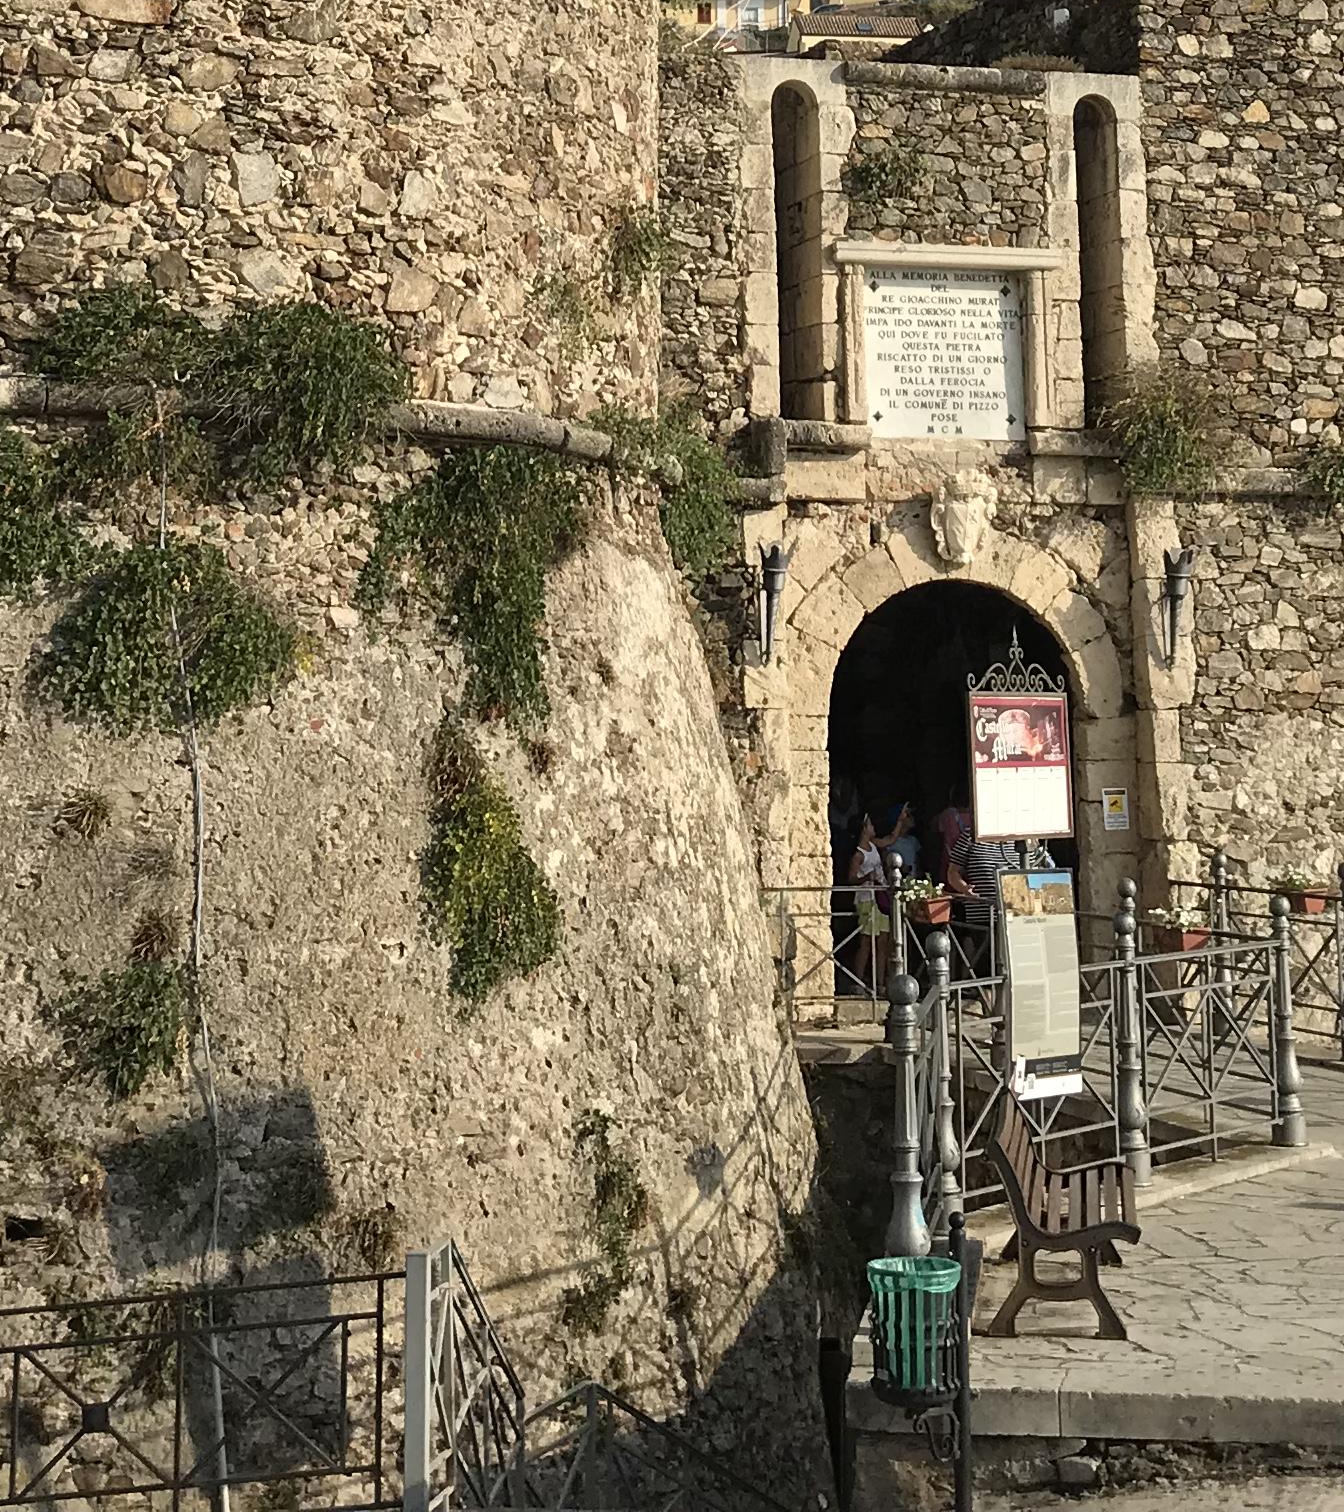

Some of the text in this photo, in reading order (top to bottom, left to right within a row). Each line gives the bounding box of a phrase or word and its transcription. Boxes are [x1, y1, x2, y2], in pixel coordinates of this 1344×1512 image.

[869, 271, 1009, 283] ALLA MEMORIA BENEDETTA
[930, 284, 949, 292] DEL
[900, 296, 962, 304] GIOACCHINO
[908, 308, 955, 316] GLORIOSO
[960, 309, 992, 317] NELLA
[998, 310, 1019, 318] VITA
[866, 318, 912, 326] IMPAIDO
[918, 320, 956, 328] DAVANTI
[981, 321, 1016, 329] MORTE
[878, 330, 895, 339] QUI
[901, 331, 928, 339] DOVE
[954, 333, 1005, 341] FUCILATO
[902, 342, 981, 352] QUESTA PIETRA
[877, 353, 927, 362] RISCATTO
[968, 356, 1008, 364] GIORNO
[894, 365, 991, 375] RESO TRISTISSIO
[900, 377, 985, 386] DALLA FEROCIA
[880, 388, 890, 396] DI
[914, 389, 964, 398] GOVERNO
[969, 391, 1006, 399] INSANO
[889, 400, 999, 410] IL COMUNE DI PIZZO
[931, 414, 958, 422] POSE
